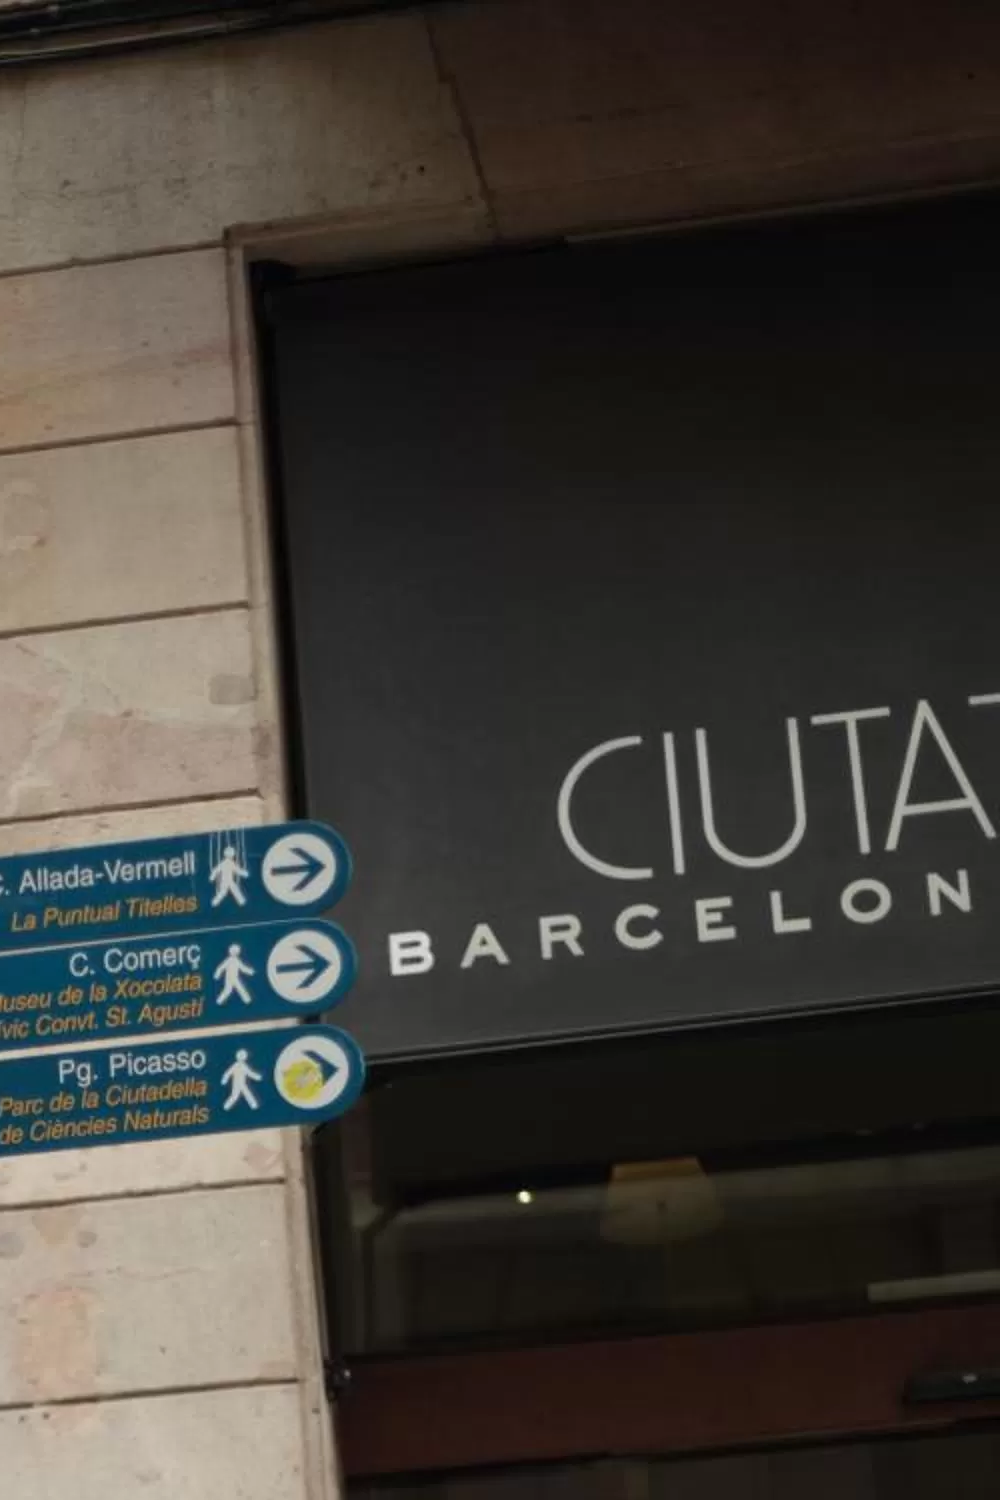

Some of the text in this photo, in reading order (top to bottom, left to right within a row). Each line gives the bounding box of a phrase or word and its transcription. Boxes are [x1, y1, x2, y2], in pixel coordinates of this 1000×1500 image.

[19, 851, 195, 893] Allada-Vermell
[11, 894, 197, 932] La Puntual Titelles
[389, 869, 972, 976] BARCELON
[69, 944, 200, 977] C. Comerç
[58, 984, 83, 1006] de
[89, 984, 107, 1003] la
[115, 973, 202, 997] Xocolata
[35, 1009, 100, 1038] Convt.
[105, 1006, 132, 1027] St.
[58, 1050, 205, 1087] Pg. Picasso
[50, 1088, 74, 1110] de
[81, 1086, 98, 1107] la
[106, 1077, 208, 1105] Ciutadella
[0, 1123, 23, 1145] de
[124, 1105, 209, 1131] Naturals
